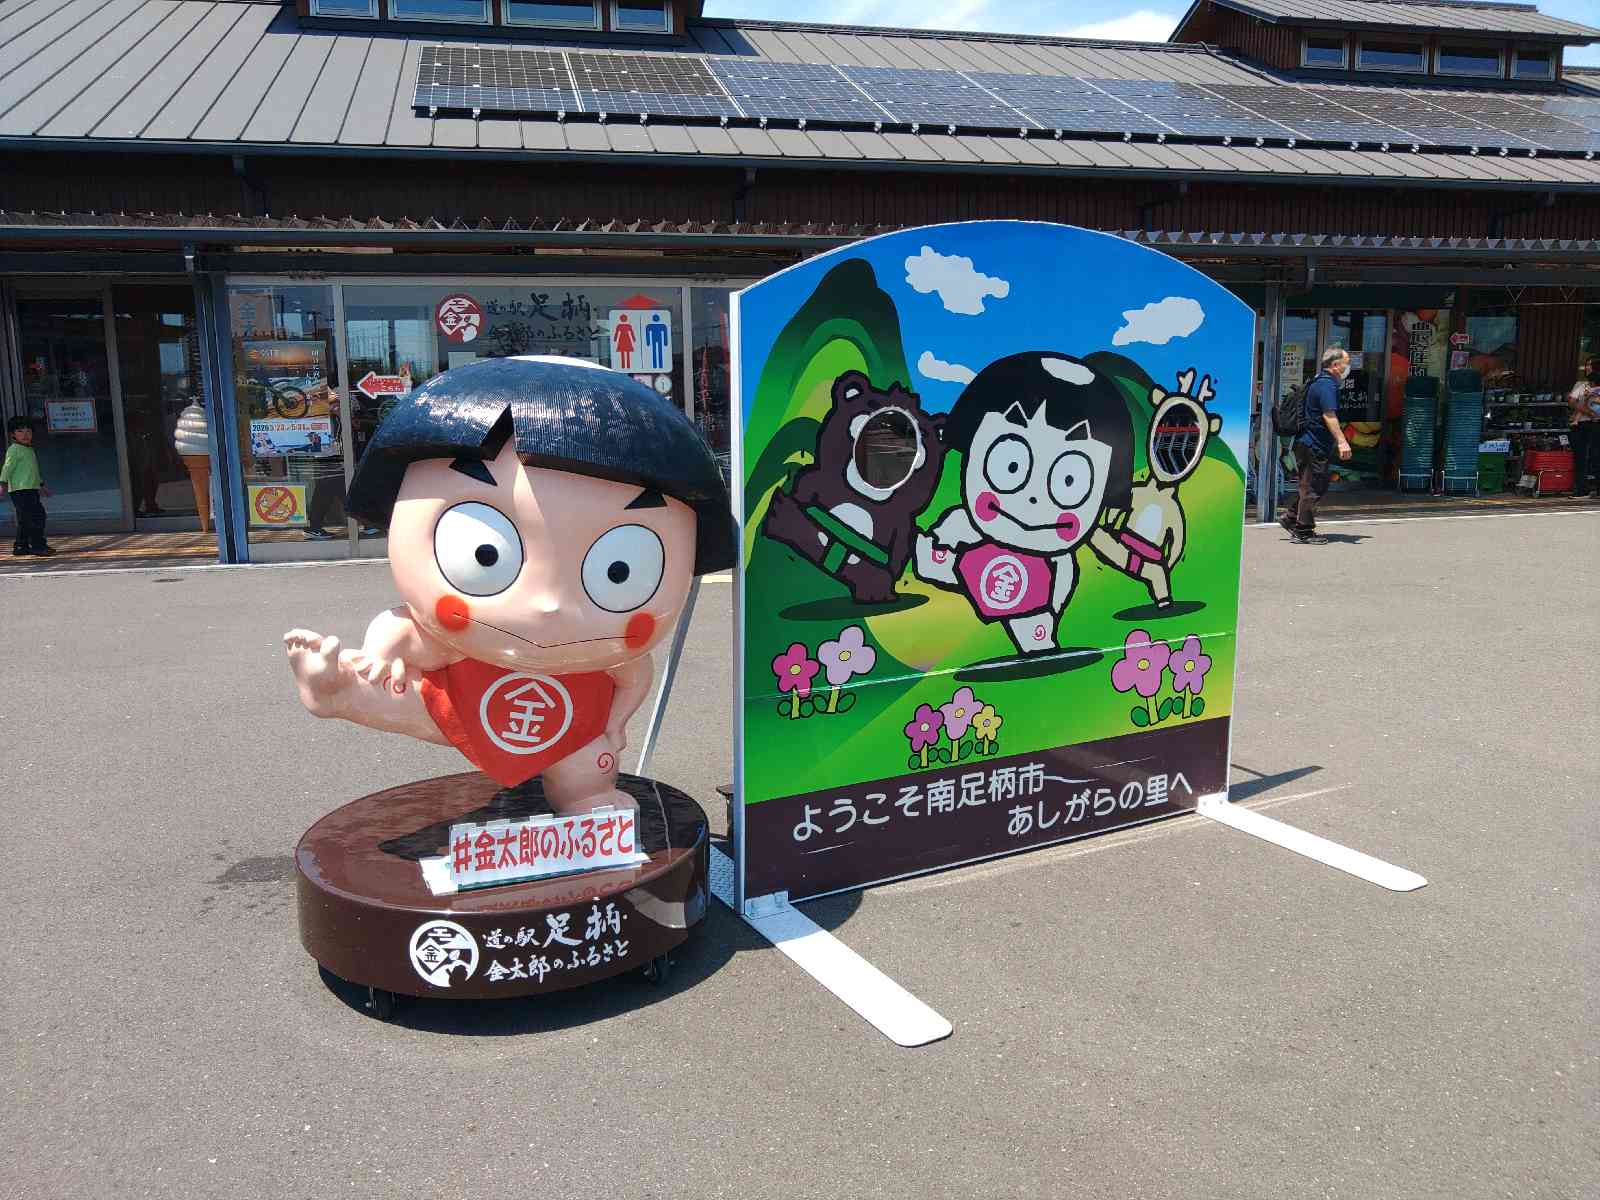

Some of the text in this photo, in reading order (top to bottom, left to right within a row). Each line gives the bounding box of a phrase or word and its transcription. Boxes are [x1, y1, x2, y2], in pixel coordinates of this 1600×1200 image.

[991, 565, 1018, 601] 金
[502, 681, 556, 742] 金
[793, 762, 1046, 842] ようこそ南足柄市
[1007, 772, 1193, 836] あしがらの里へ
[483, 939, 630, 984] 金太郎のふるさと
